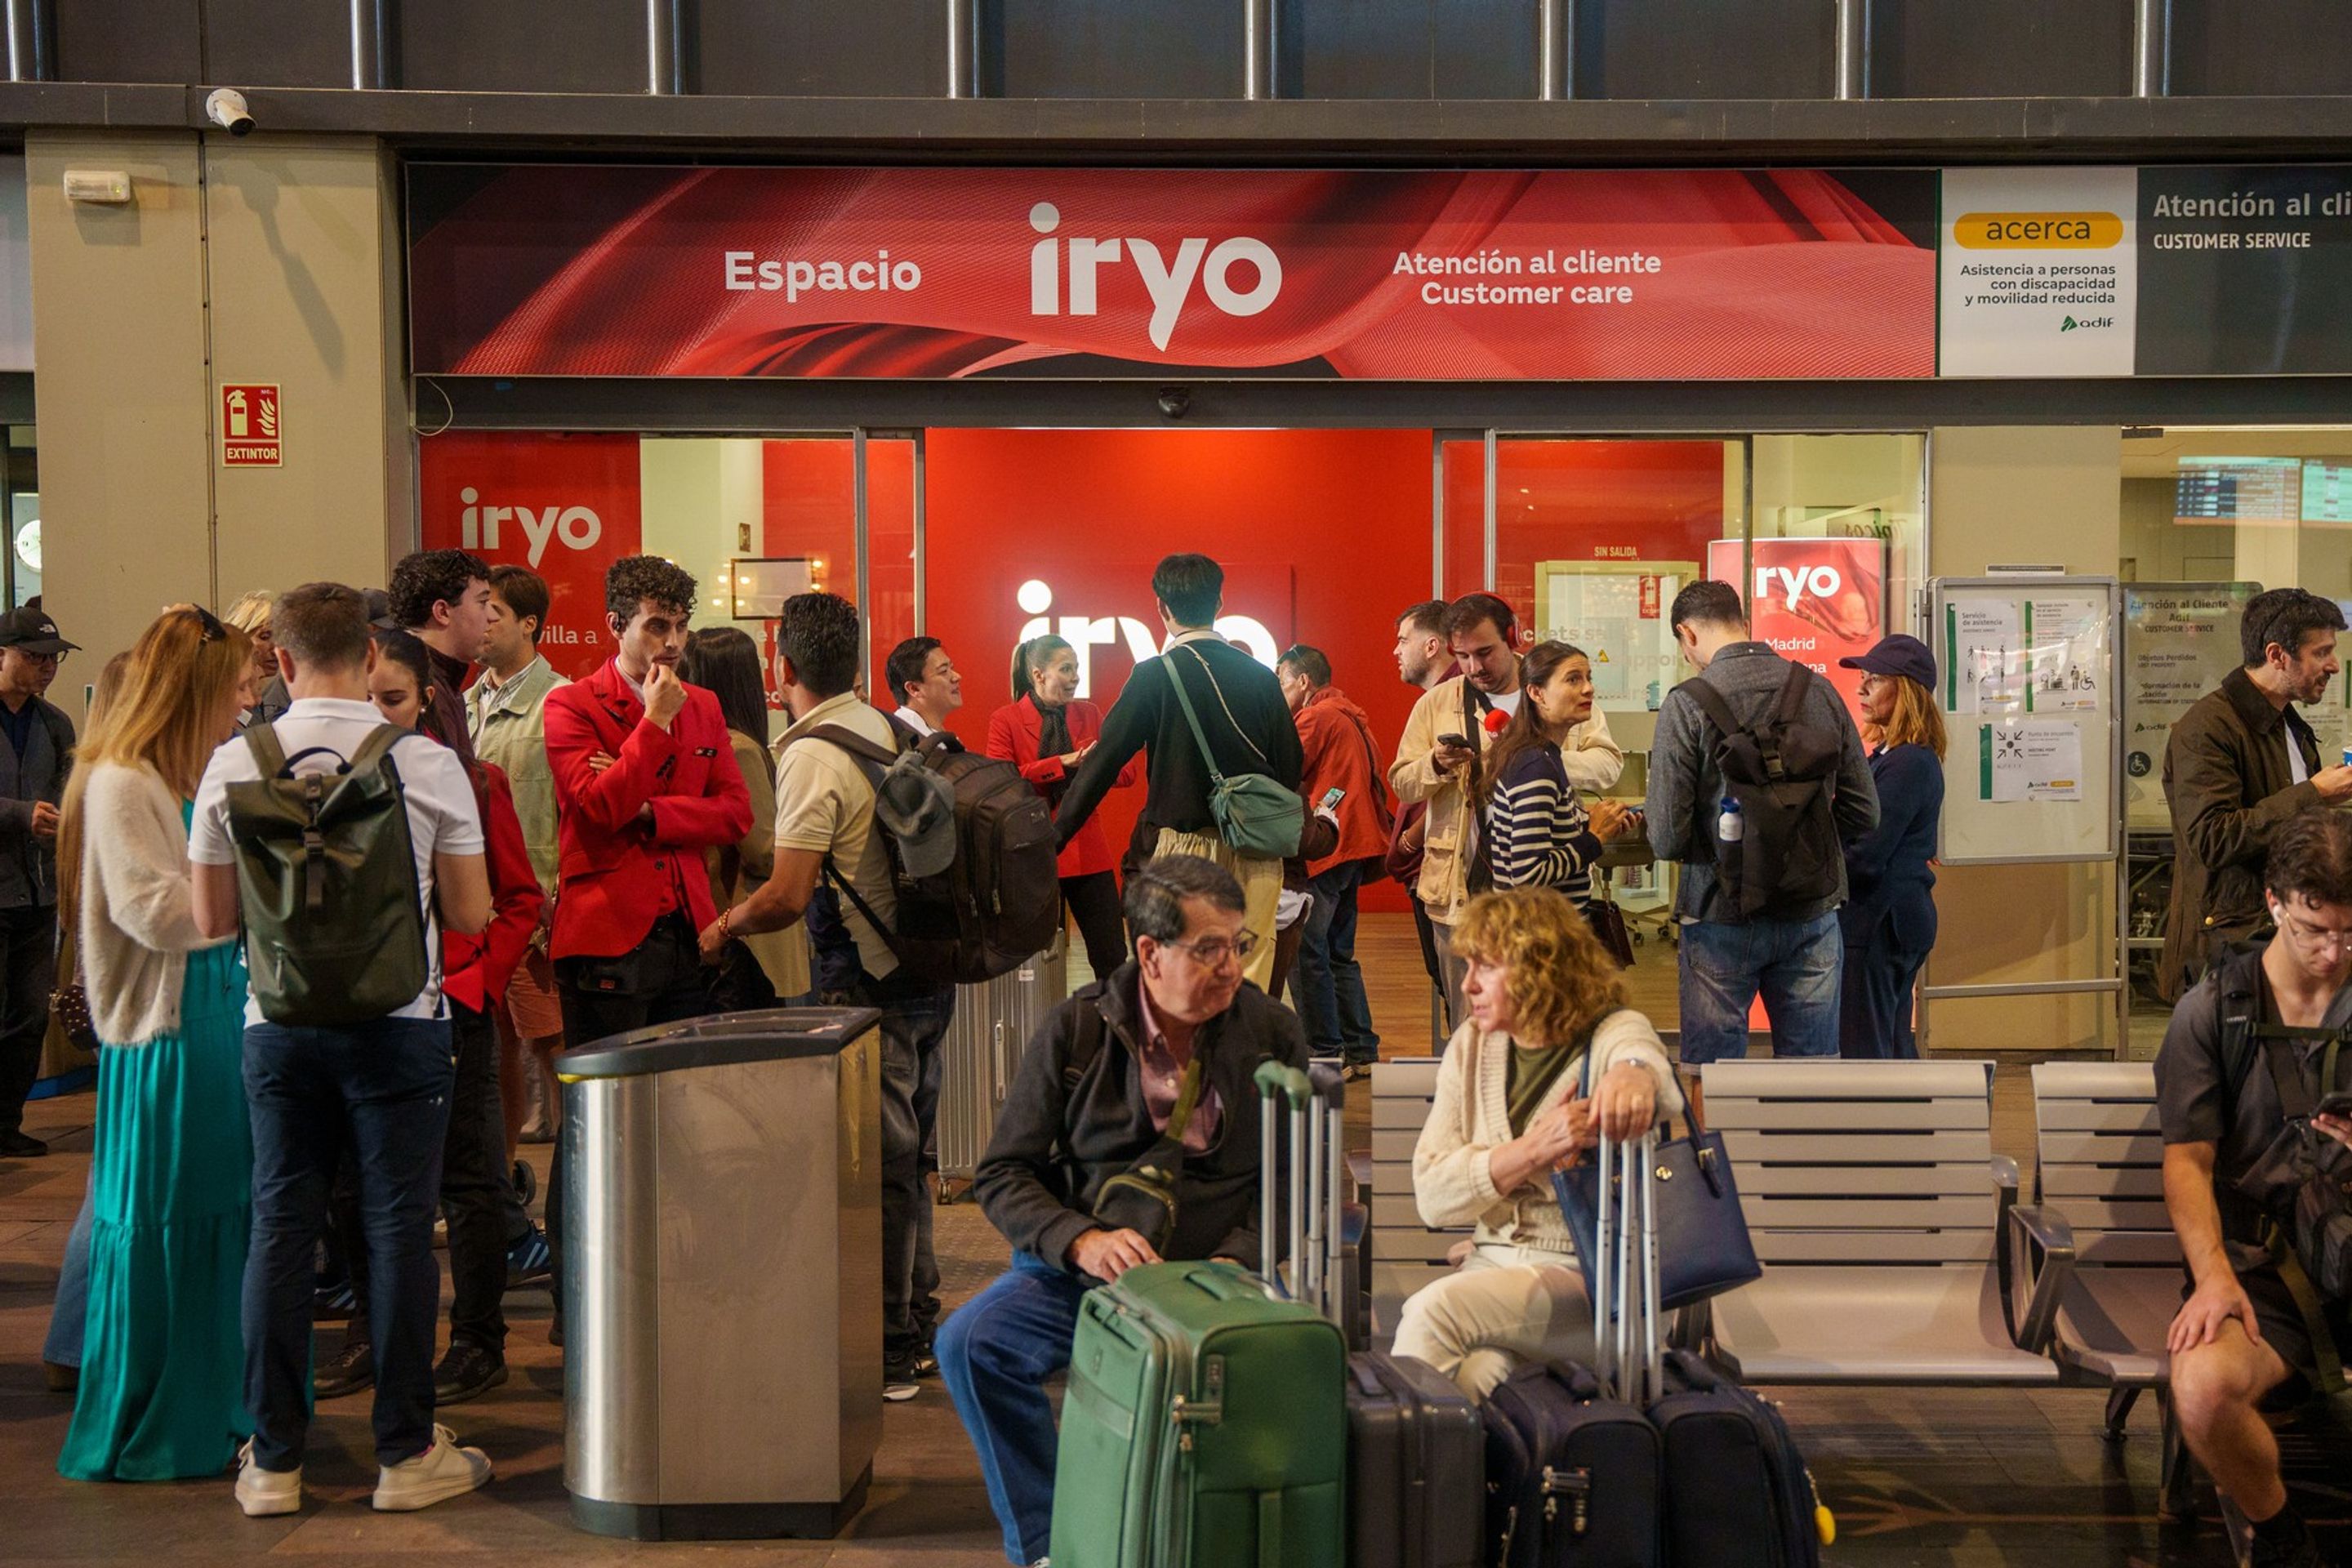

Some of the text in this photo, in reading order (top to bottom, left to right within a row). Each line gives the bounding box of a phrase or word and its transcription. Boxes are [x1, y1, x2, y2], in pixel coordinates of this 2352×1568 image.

[2154, 191, 2274, 217] Atención
[2287, 193, 2310, 216] al
[1986, 220, 2091, 240] acerca
[2154, 233, 2310, 249] CUSTOMER SERVICE
[1392, 249, 1661, 274] Atención al cliente
[724, 249, 921, 303] Espacio
[1030, 202, 1282, 352] iryo
[1961, 265, 2116, 278] Asistencia a personas
[1990, 278, 2116, 292] con discapacidad
[1421, 282, 1633, 305] Customer care
[1965, 292, 2116, 306] y movilidad reducida
[2080, 317, 2114, 328] adif
[227, 448, 278, 459] EXTINTOR
[461, 487, 602, 570] iryo
[1594, 546, 1637, 557] SIN SALIDA
[1756, 565, 1841, 612] ryo
[2180, 599, 2189, 608] al
[2193, 599, 2229, 608] Cliente
[585, 630, 598, 644] a
